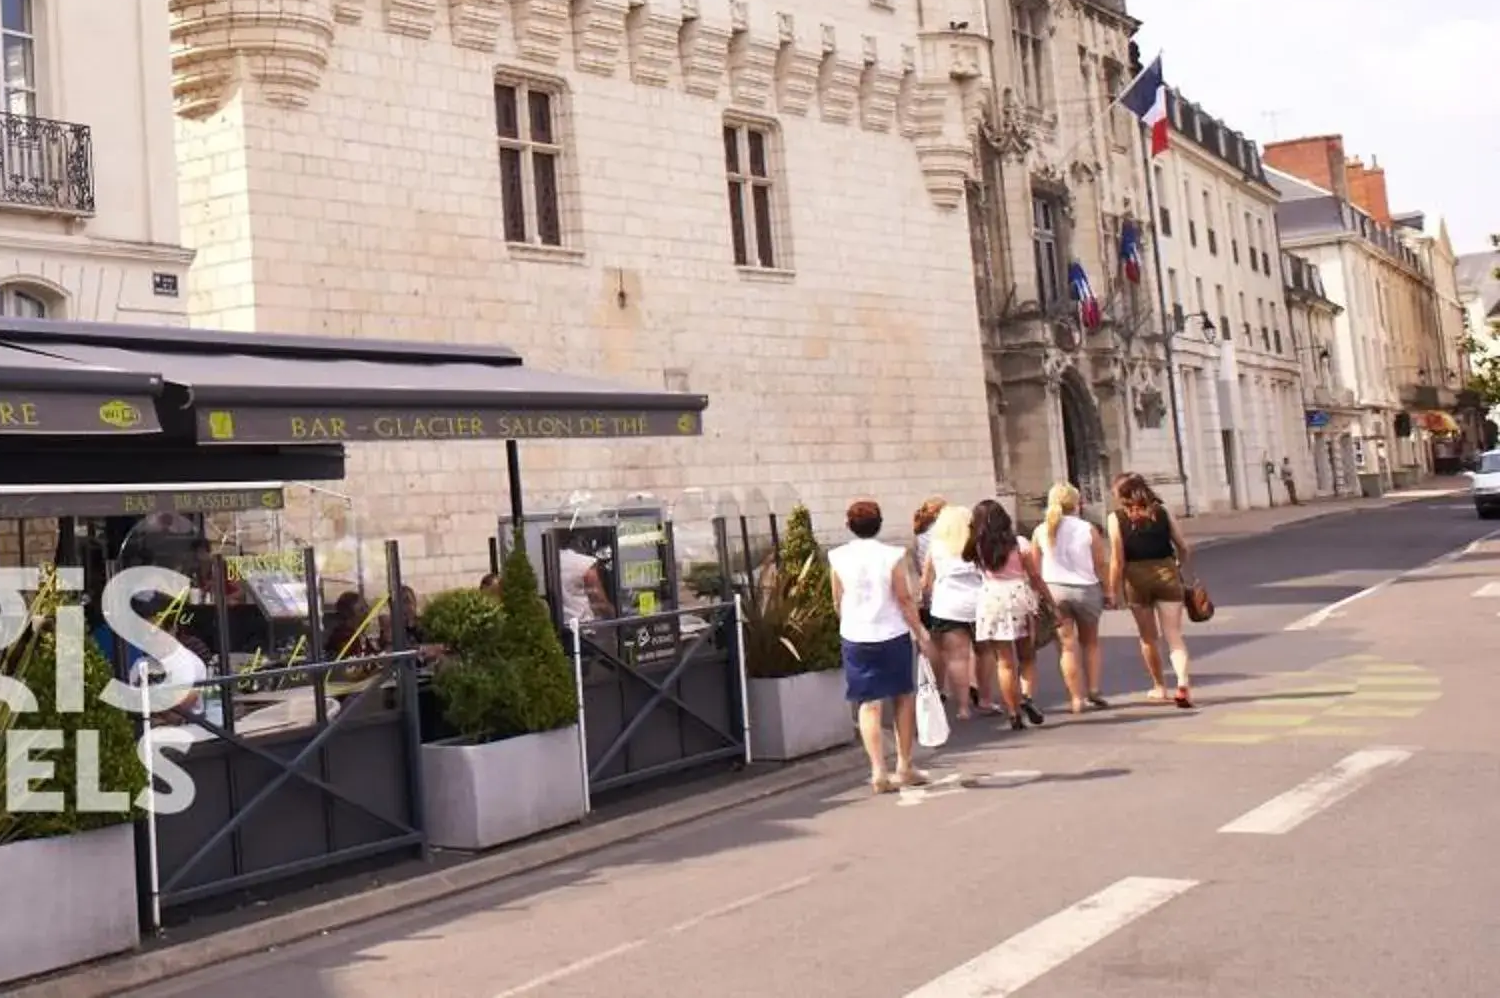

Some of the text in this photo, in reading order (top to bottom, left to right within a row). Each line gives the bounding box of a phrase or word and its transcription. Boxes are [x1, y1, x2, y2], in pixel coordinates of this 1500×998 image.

[290, 416, 350, 438] BAR
[374, 416, 485, 438] GLACIER
[499, 417, 573, 437] SALON
[579, 416, 605, 436] DE
[124, 493, 156, 512] BAR
